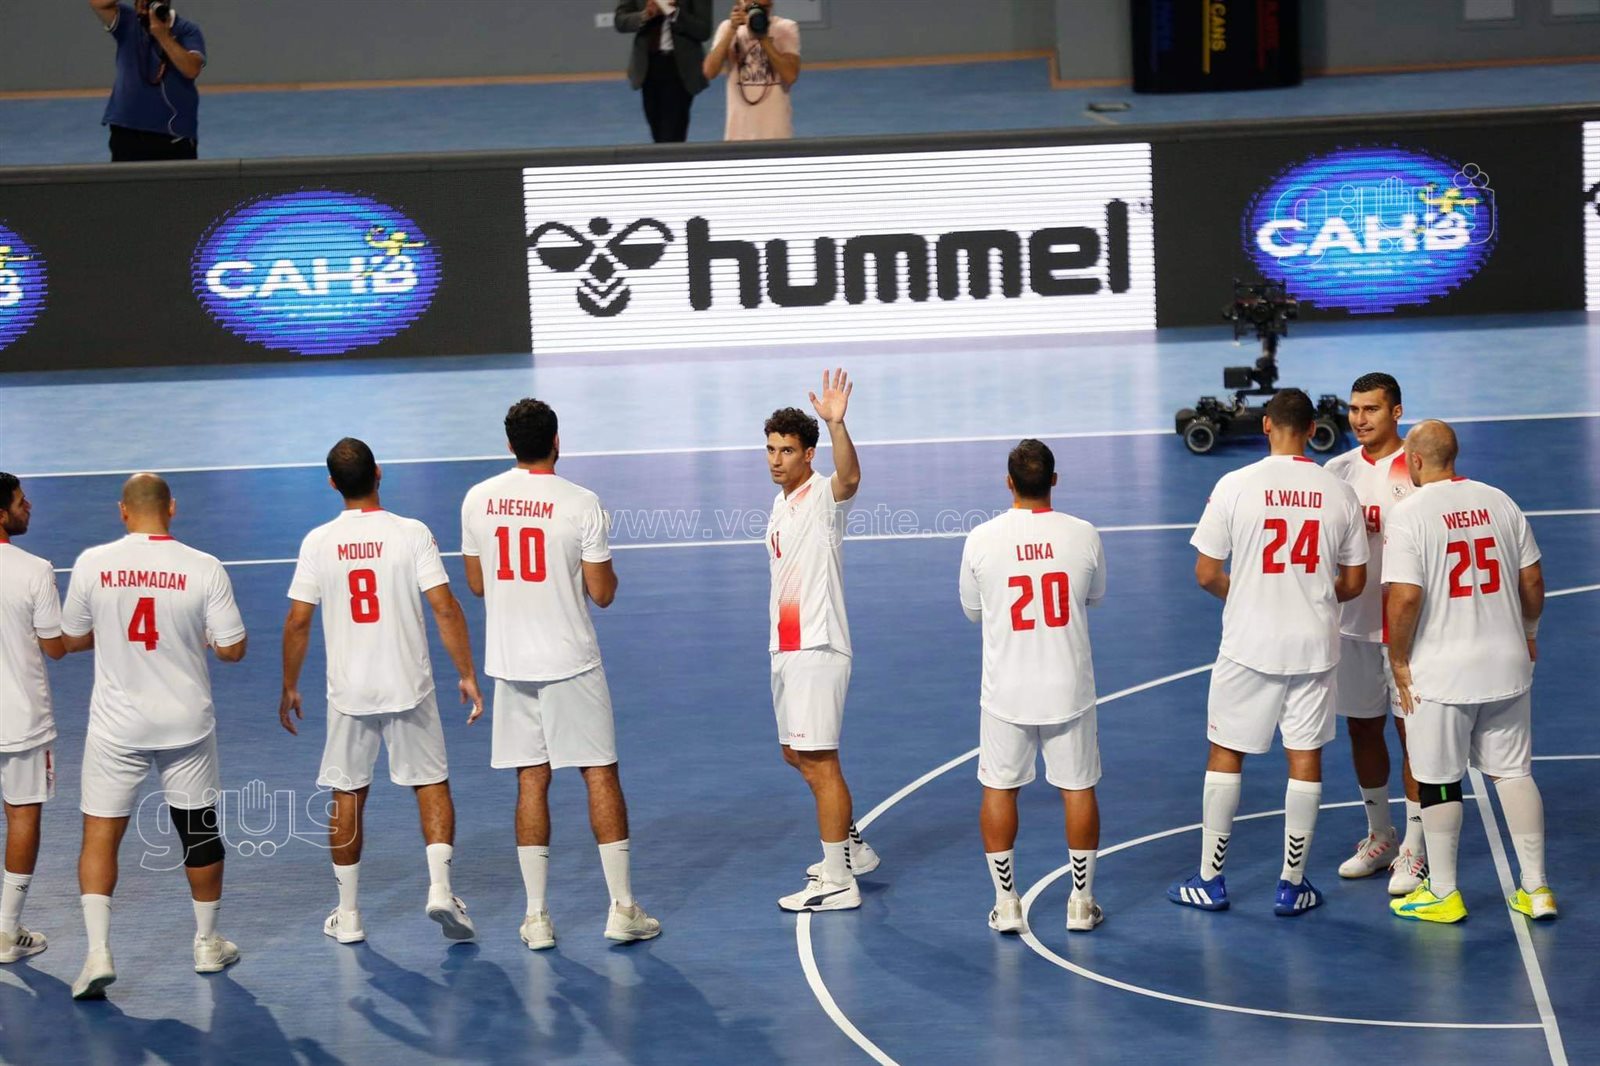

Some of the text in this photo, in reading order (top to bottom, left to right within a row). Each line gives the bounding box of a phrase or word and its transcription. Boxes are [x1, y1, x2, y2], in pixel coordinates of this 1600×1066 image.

[687, 198, 1130, 311] hummel
[1255, 212, 1473, 258] CAHB
[206, 255, 419, 299] CAHB
[486, 498, 554, 519] A.HESHAM
[1265, 490, 1322, 509] K.WALID
[1444, 509, 1491, 531] WESAM
[338, 542, 383, 561] MOUDY
[495, 526, 547, 584] 10
[1017, 543, 1054, 561] LOKA
[1262, 517, 1321, 574] 24
[1446, 536, 1501, 599] 25
[100, 570, 187, 590] M.RAMADAN
[346, 568, 381, 624] 8
[1008, 571, 1071, 632] 20
[128, 597, 160, 651] 4
